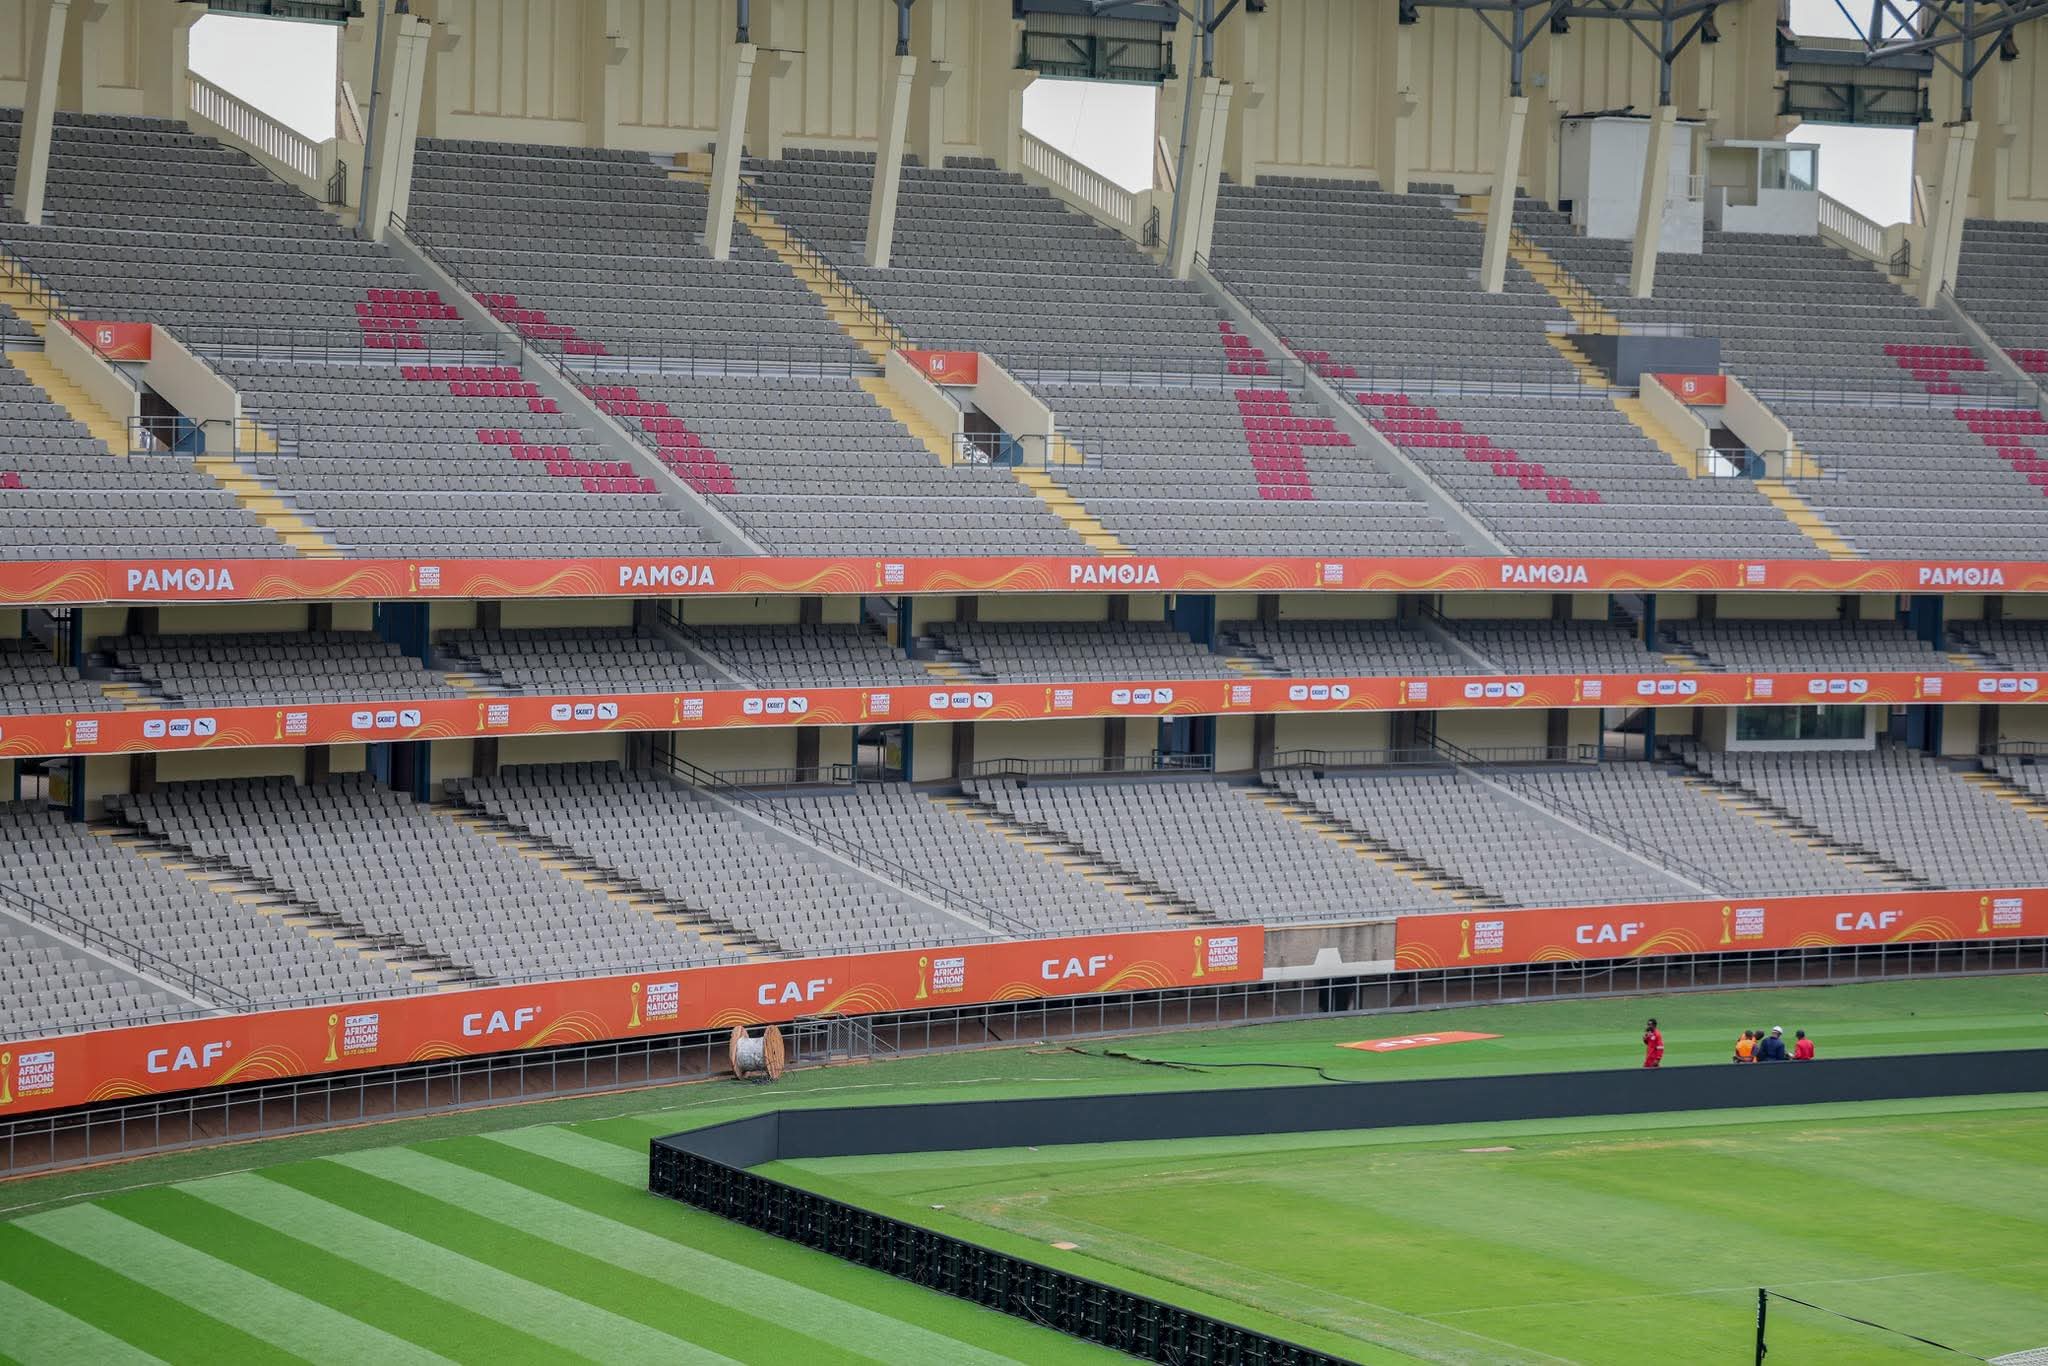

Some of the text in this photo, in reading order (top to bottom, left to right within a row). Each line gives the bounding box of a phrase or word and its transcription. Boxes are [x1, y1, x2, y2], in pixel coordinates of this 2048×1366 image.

[98, 330, 112, 344] 15
[931, 359, 944, 371] 14
[127, 568, 234, 592] PAMOJA
[619, 565, 715, 586] PAMOJA
[1070, 564, 1160, 584] PAMOJA
[1501, 564, 1588, 583] PAMOJA
[1919, 567, 2004, 585] PAMOJA
[1835, 911, 1897, 930] CAF
[1575, 922, 1639, 944] CAF
[1208, 946, 1238, 956] AFRICAN
[1208, 954, 1238, 963] NATIONS
[934, 967, 965, 977] AFRICAN
[1041, 955, 1107, 980] CAF
[933, 975, 964, 985] NATIONS
[647, 992, 678, 1004] AFRICAN
[758, 979, 826, 1005] CAF
[647, 1001, 678, 1012] NATIONS
[462, 1007, 534, 1037] CAF
[345, 1024, 378, 1037] AFRICAN
[344, 1034, 377, 1046] NATIONS
[147, 1040, 223, 1074] CAF
[19, 1063, 54, 1076] AFRICAN
[19, 1073, 54, 1086] NATIONS
